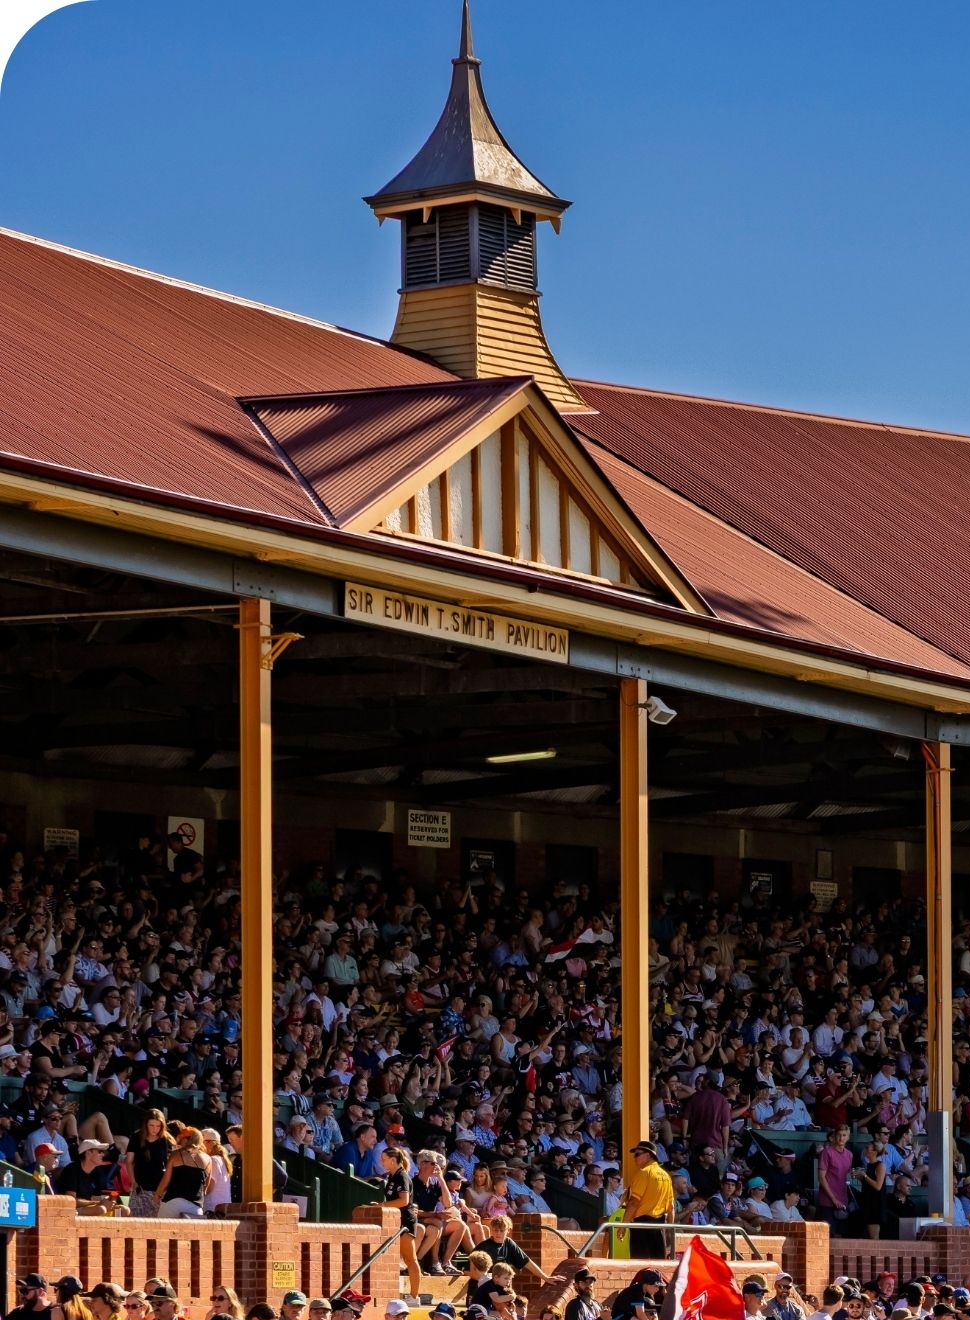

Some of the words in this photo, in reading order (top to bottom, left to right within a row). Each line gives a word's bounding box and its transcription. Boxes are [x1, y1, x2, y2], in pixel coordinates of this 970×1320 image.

[348, 589, 373, 615] SIR
[384, 596, 430, 627] EDWIN
[507, 623, 567, 655] PAVILION
[410, 813, 439, 824] SECTION
[441, 815, 447, 825] E
[410, 825, 438, 833] RESERVED
[273, 1262, 294, 1270] CAUTION
